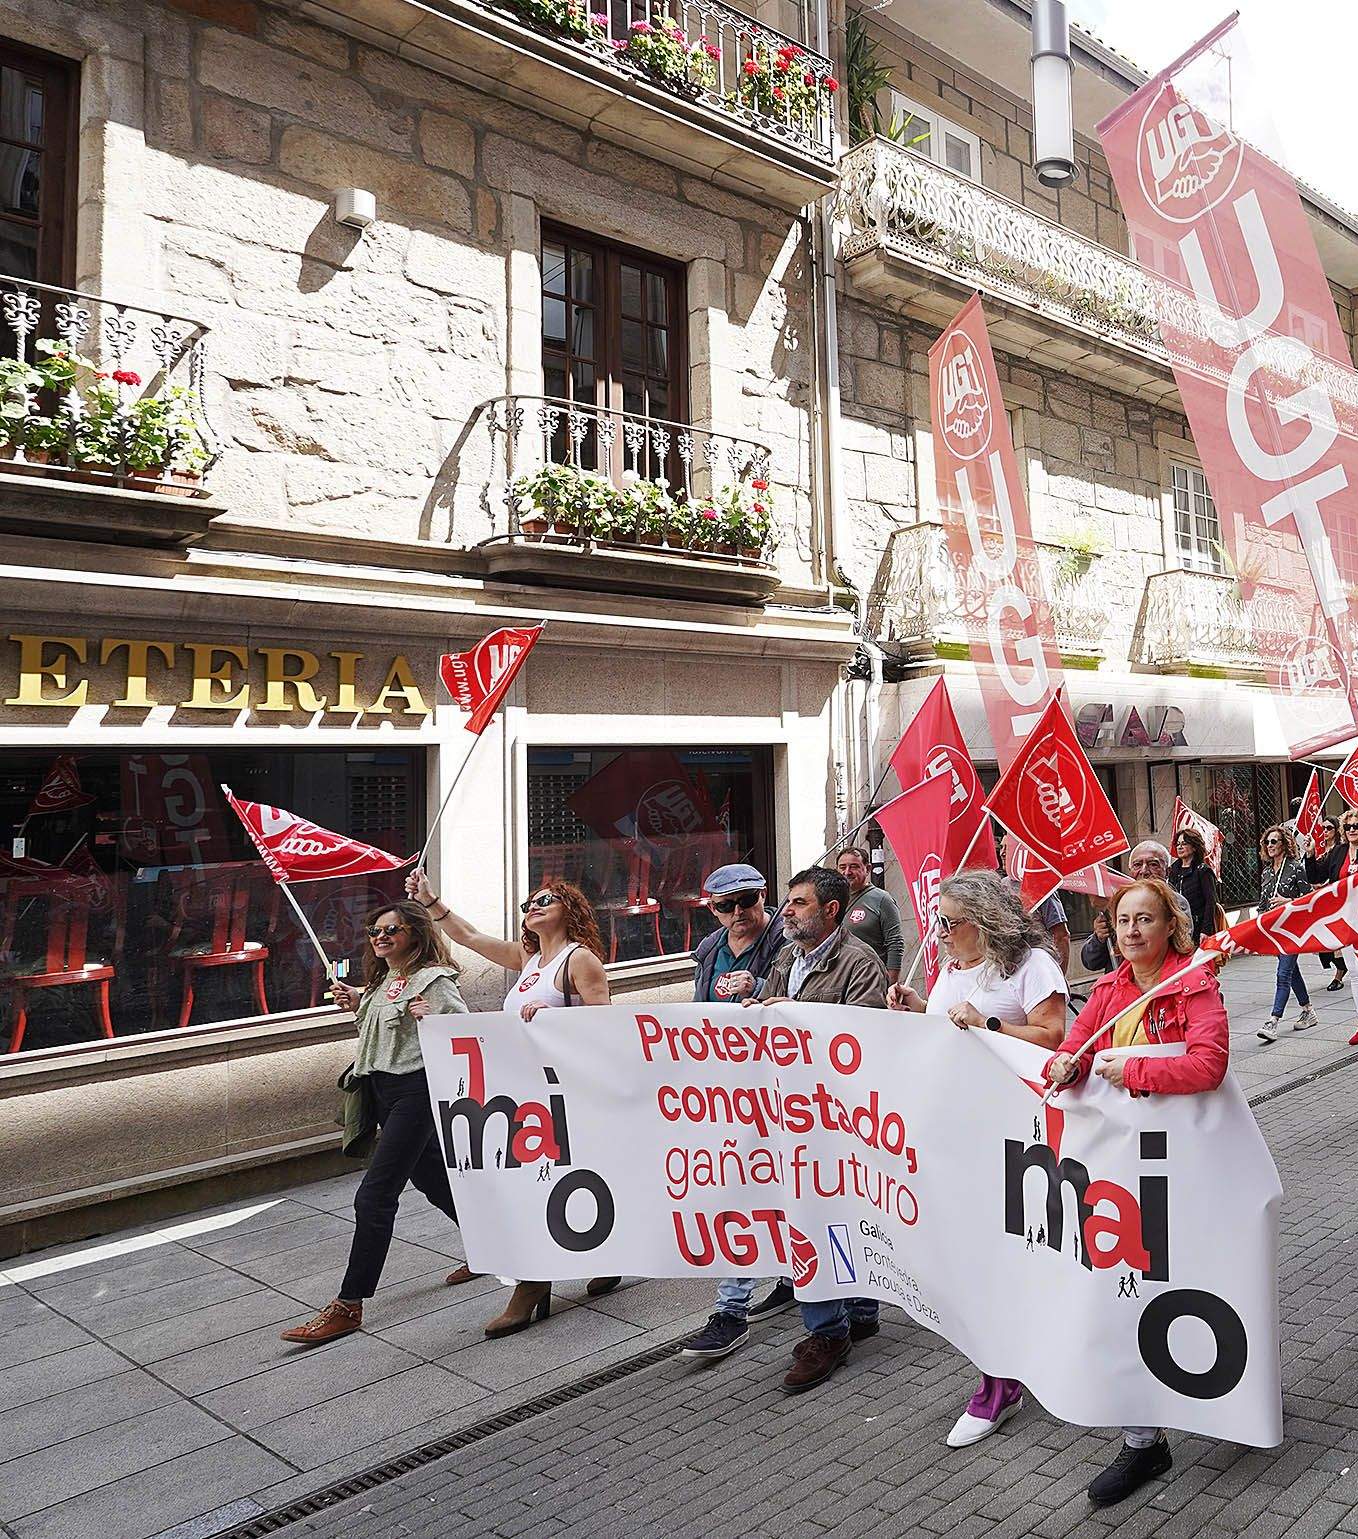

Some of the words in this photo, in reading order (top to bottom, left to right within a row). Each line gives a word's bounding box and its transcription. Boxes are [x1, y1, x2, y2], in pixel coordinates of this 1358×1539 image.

[1145, 103, 1225, 181] UGT
[942, 347, 981, 408] UGT
[1178, 189, 1349, 619] UGT
[954, 450, 1050, 737] UG
[5, 634, 432, 715] ETERIA
[634, 1014, 813, 1067] Protexer
[829, 1033, 862, 1075] o
[657, 1077, 918, 1174] conquistado,
[791, 1144, 919, 1226] futuro
[672, 1209, 788, 1267] UGT
[859, 1219, 895, 1251] Galicia
